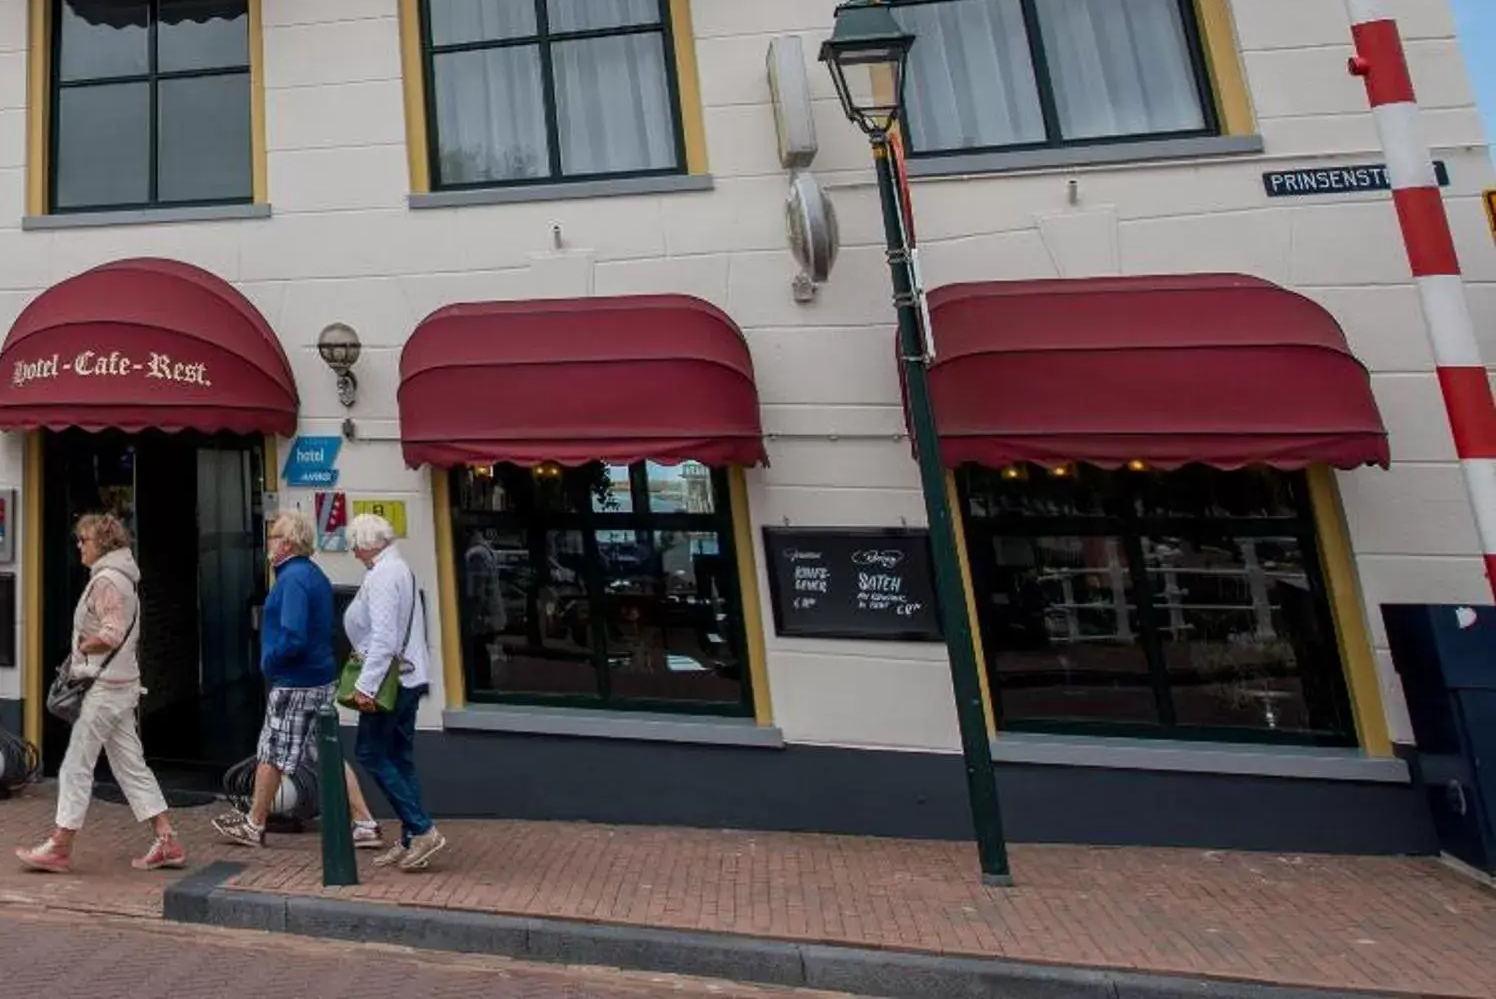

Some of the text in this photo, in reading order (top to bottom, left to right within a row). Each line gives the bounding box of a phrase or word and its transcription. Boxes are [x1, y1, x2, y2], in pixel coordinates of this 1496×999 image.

[1271, 167, 1391, 193] PRINSENST
[296, 448, 325, 463] hotel
[858, 572, 903, 593] SATEH
